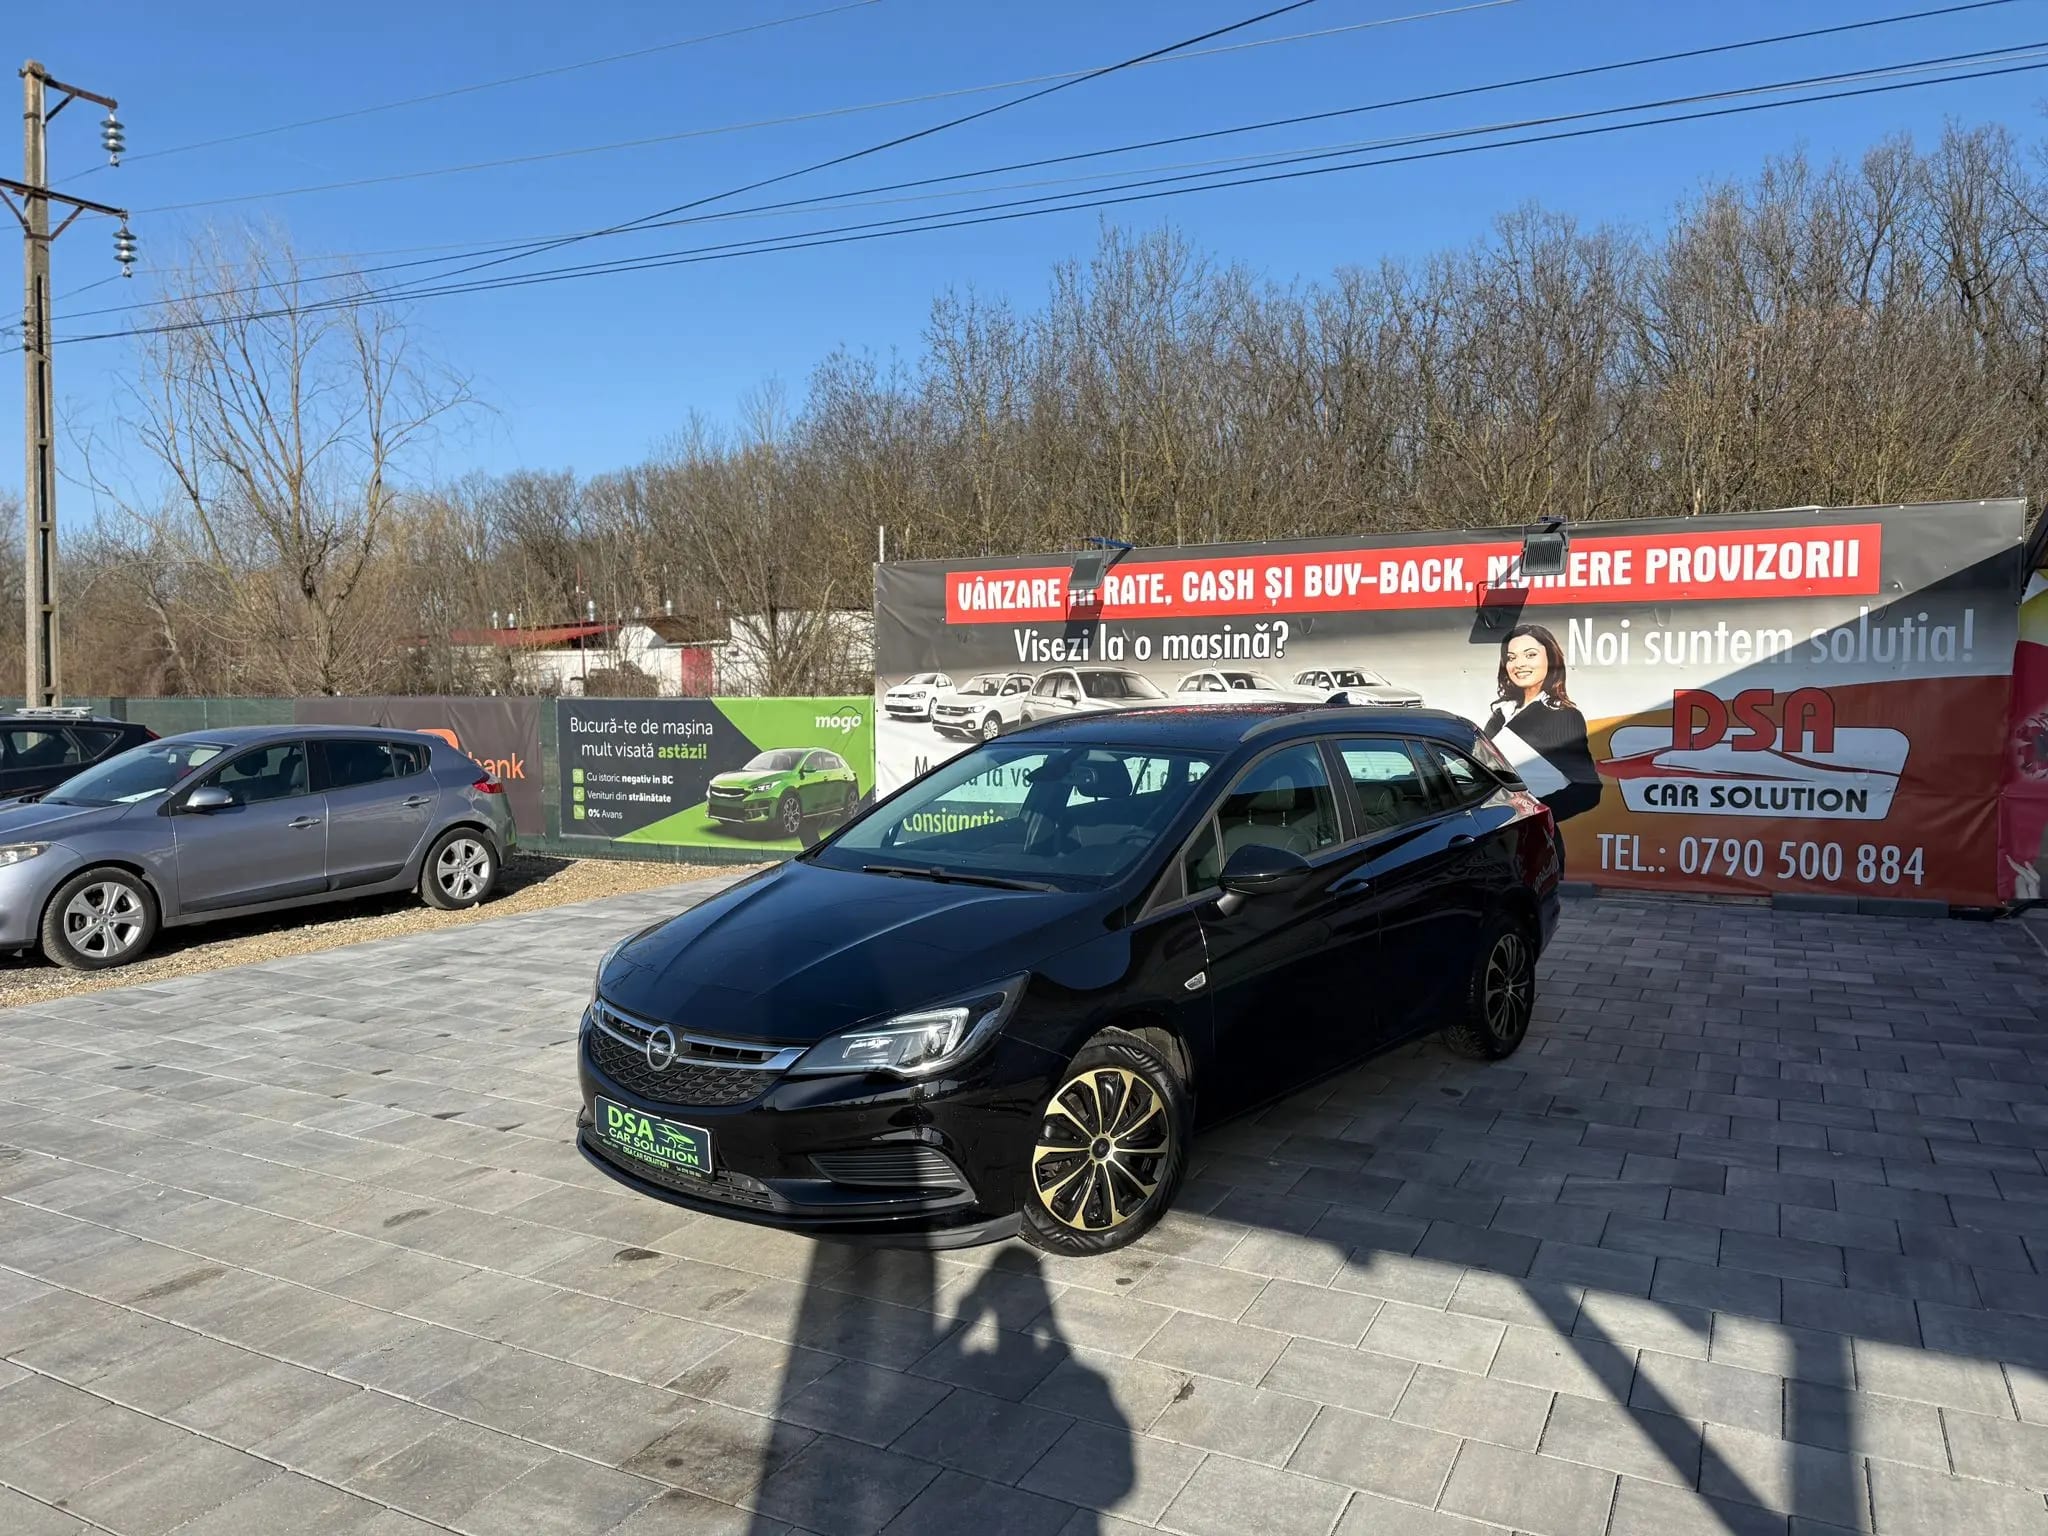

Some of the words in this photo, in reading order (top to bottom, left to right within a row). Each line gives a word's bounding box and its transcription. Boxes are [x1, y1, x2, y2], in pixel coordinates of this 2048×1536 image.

[958, 576, 1061, 610] VÂNZARE
[1103, 573, 1173, 606] RATE,
[1182, 568, 1254, 603] CASH
[1264, 566, 1293, 607] ȘI
[1304, 556, 1474, 598] BUY-BACK,
[1645, 539, 1860, 585] PROVIZORII
[1013, 628, 1090, 662] Visezi
[1099, 623, 1125, 662] la
[1134, 635, 1151, 661] o
[1568, 617, 1631, 666] Noi
[1644, 621, 1793, 666] suntem
[570, 717, 637, 734] Bucură-te
[640, 718, 659, 735] de
[662, 719, 713, 739] mașina
[815, 715, 862, 735] mogo
[1673, 687, 1835, 753] DSA
[581, 741, 612, 757] mult
[614, 742, 654, 759] visată
[658, 743, 707, 759] astăzi!
[587, 772, 598, 782] Cu
[599, 772, 621, 783] istoric
[621, 774, 652, 785] negativ
[662, 775, 674, 785] BC
[586, 790, 615, 801] Venituri
[615, 791, 628, 801] din
[1643, 783, 1699, 807] CAR
[1709, 785, 1868, 813] SOLUTION
[588, 808, 600, 818] 0%
[601, 809, 623, 820] Avans
[1596, 832, 1666, 873] TEL.:
[1678, 836, 1764, 878] 0790
[1776, 841, 1843, 881] 500
[1856, 844, 1925, 886] 884
[607, 1105, 655, 1142] DSA
[608, 1127, 632, 1144] CAR
[634, 1136, 699, 1166] SOLUTION
